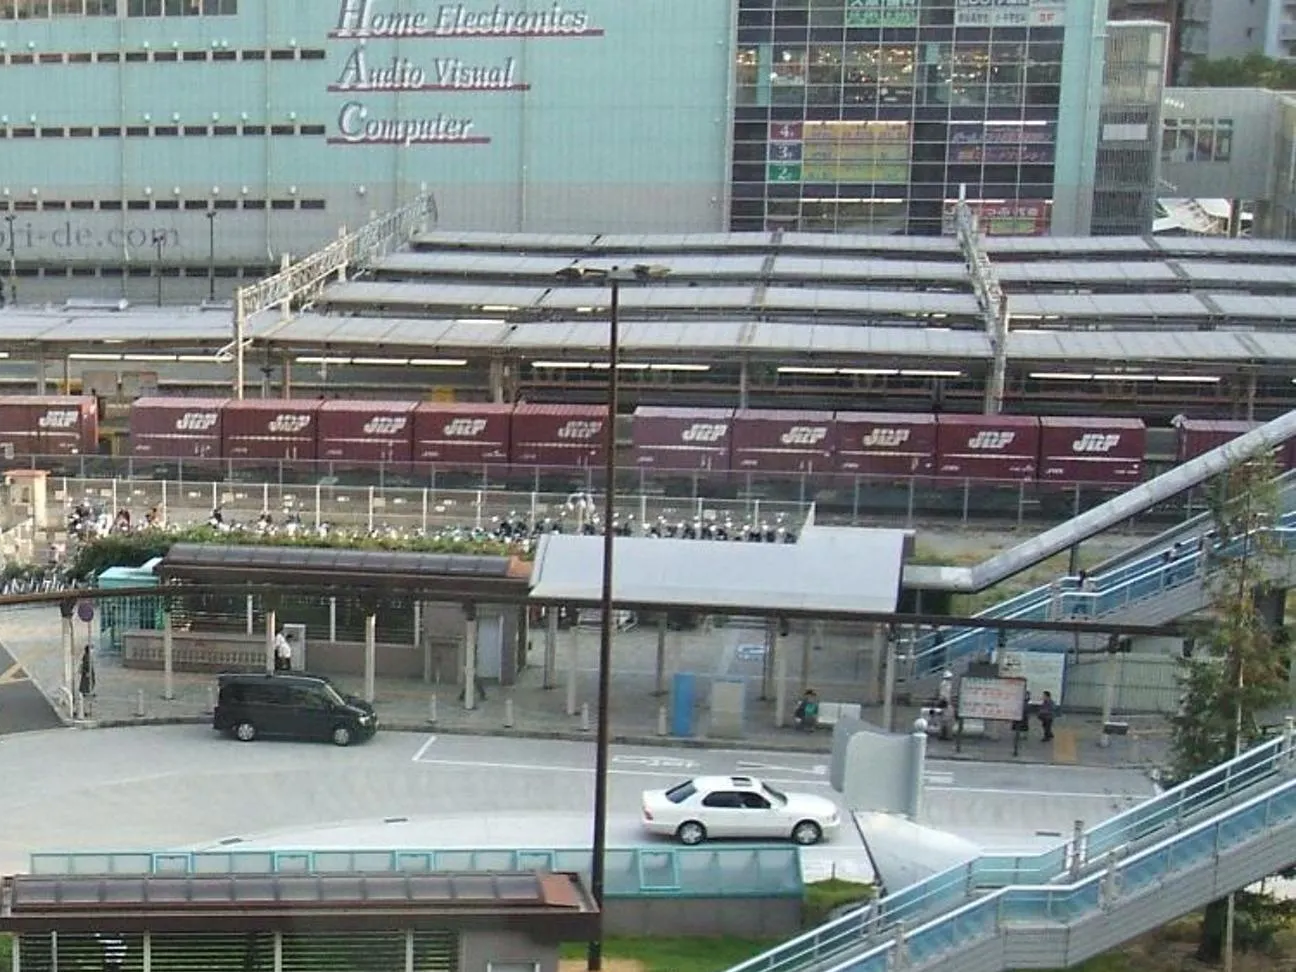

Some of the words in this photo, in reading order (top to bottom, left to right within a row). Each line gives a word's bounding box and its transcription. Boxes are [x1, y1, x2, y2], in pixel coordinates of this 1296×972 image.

[337, 0, 426, 35] Home
[436, 1, 588, 33] Electronics
[337, 43, 424, 88] Audio
[434, 56, 515, 88] Visual
[338, 101, 473, 145] Computer
